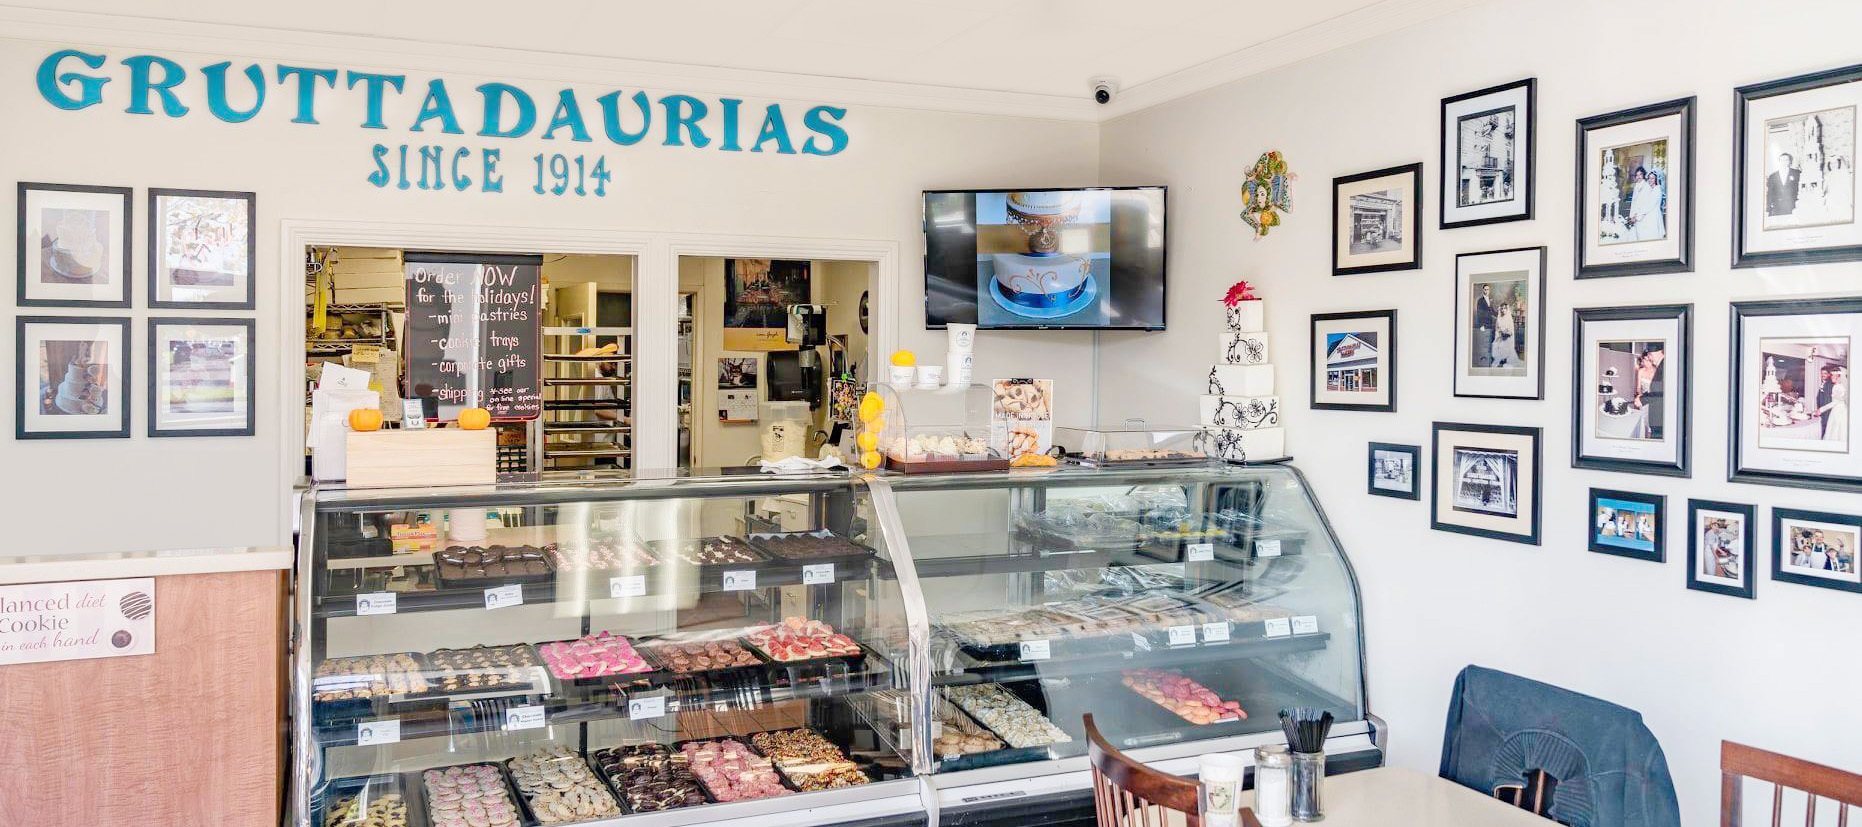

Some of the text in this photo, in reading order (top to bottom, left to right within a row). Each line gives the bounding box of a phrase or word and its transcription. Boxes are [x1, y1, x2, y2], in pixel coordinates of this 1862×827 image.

[36, 49, 851, 156] GRUTTADAURIAS
[368, 144, 611, 197] SINCE 1914
[415, 265, 518, 287] Order NOW
[416, 287, 435, 303] for
[442, 289, 464, 304] the
[490, 330, 519, 351] trays
[498, 353, 526, 374] gifts
[496, 402, 510, 411] free
[513, 403, 540, 411] cookies
[76, 592, 107, 609] diet
[0, 614, 69, 633] Cookie
[20, 636, 47, 651] each
[53, 628, 100, 648] hand
